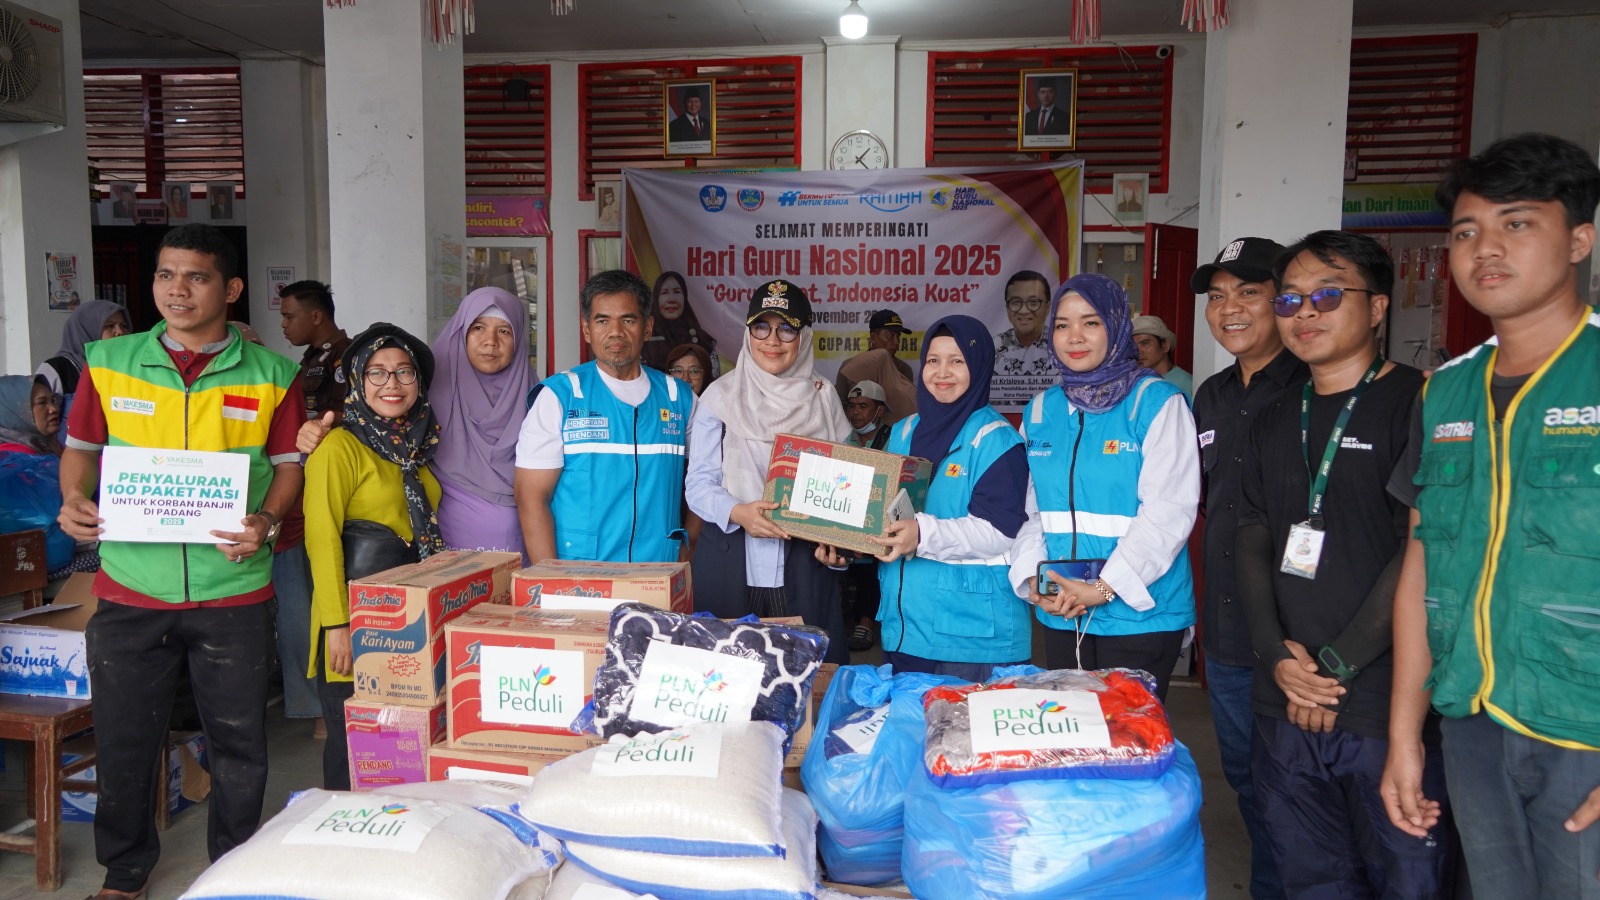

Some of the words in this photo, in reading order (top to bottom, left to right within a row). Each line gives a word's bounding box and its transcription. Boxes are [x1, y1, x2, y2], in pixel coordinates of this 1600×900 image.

[29, 18, 60, 33] SHARP
[873, 146, 879, 154] 2
[1365, 195, 1393, 212] Dari
[755, 223, 816, 239] SELAMAT
[821, 222, 929, 238] MEMPERINGATI
[687, 245, 735, 277] Hari
[743, 245, 801, 277] Guru
[810, 243, 926, 276] Nasional
[934, 244, 1001, 276] 2025
[827, 281, 919, 303] Indonesia
[924, 283, 980, 304] Kuat”
[818, 337, 861, 352] CUPAK
[123, 399, 154, 410] YAKESMA
[1543, 425, 1599, 437] humanity
[166, 456, 204, 465] YAKESMA
[118, 471, 232, 488] PENYALURAN
[806, 477, 831, 493] PLN
[106, 483, 137, 495] 100
[141, 485, 196, 498] PAKET
[199, 488, 240, 500] NASI
[112, 497, 147, 506] UNTUK
[150, 499, 195, 508] KORBAN
[196, 501, 234, 510] BANJIR
[803, 489, 852, 514] Peduli
[143, 508, 154, 516] DI
[157, 508, 202, 517] PADANG
[361, 635, 383, 648] Kari
[384, 637, 415, 652] Ayam
[0, 645, 61, 669] Sajuak
[499, 676, 531, 693] PLN
[660, 674, 697, 695] PLN
[499, 691, 563, 714] Peduli
[653, 689, 729, 723] Peduli
[993, 707, 1036, 720] PLN
[994, 717, 1080, 737] Peduli
[614, 746, 694, 763] Peduli
[357, 760, 393, 770] RENDANG
[328, 808, 375, 819] PLN
[315, 816, 407, 837] Peduli
